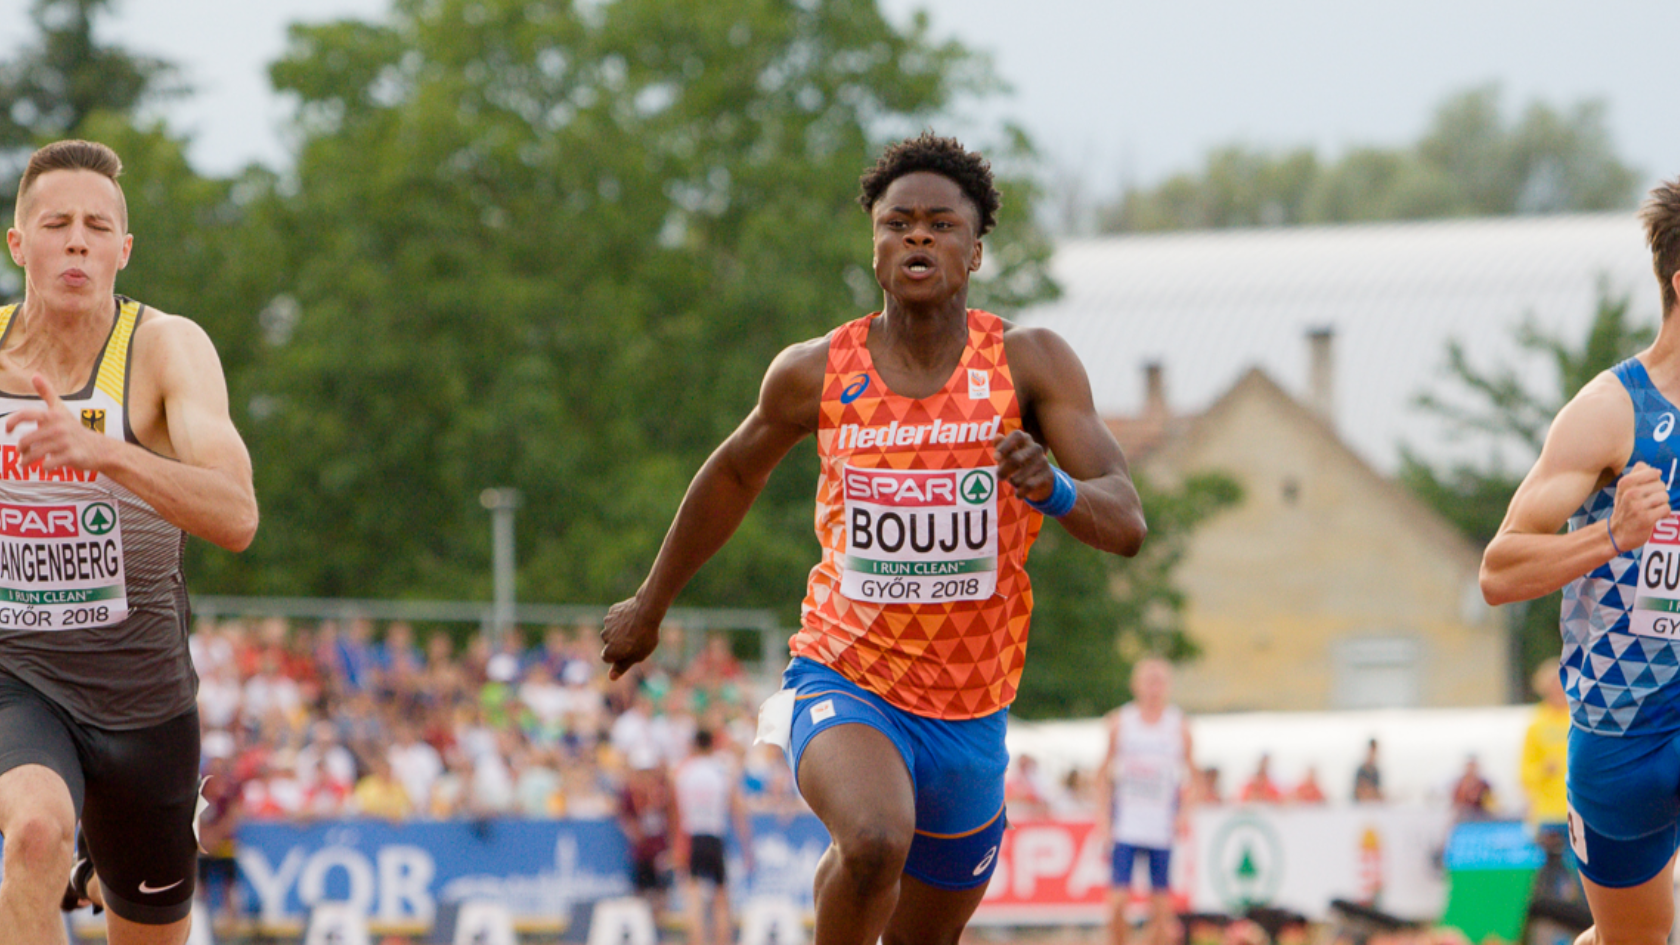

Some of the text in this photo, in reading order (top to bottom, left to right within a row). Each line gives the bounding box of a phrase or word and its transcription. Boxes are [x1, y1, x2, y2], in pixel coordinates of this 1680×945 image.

[847, 474, 953, 503] SPAR
[0, 508, 75, 534] PAR
[852, 507, 988, 553] BOUJU
[1653, 518, 1680, 541] S
[0, 539, 118, 582] ANGENBERG
[873, 562, 877, 572] I
[881, 563, 910, 574] RUN
[15, 591, 40, 603] RUN
[861, 577, 979, 599] GYŐR 2018
[0, 605, 109, 627] GYŐR 2018
[233, 826, 437, 926] YŐR
